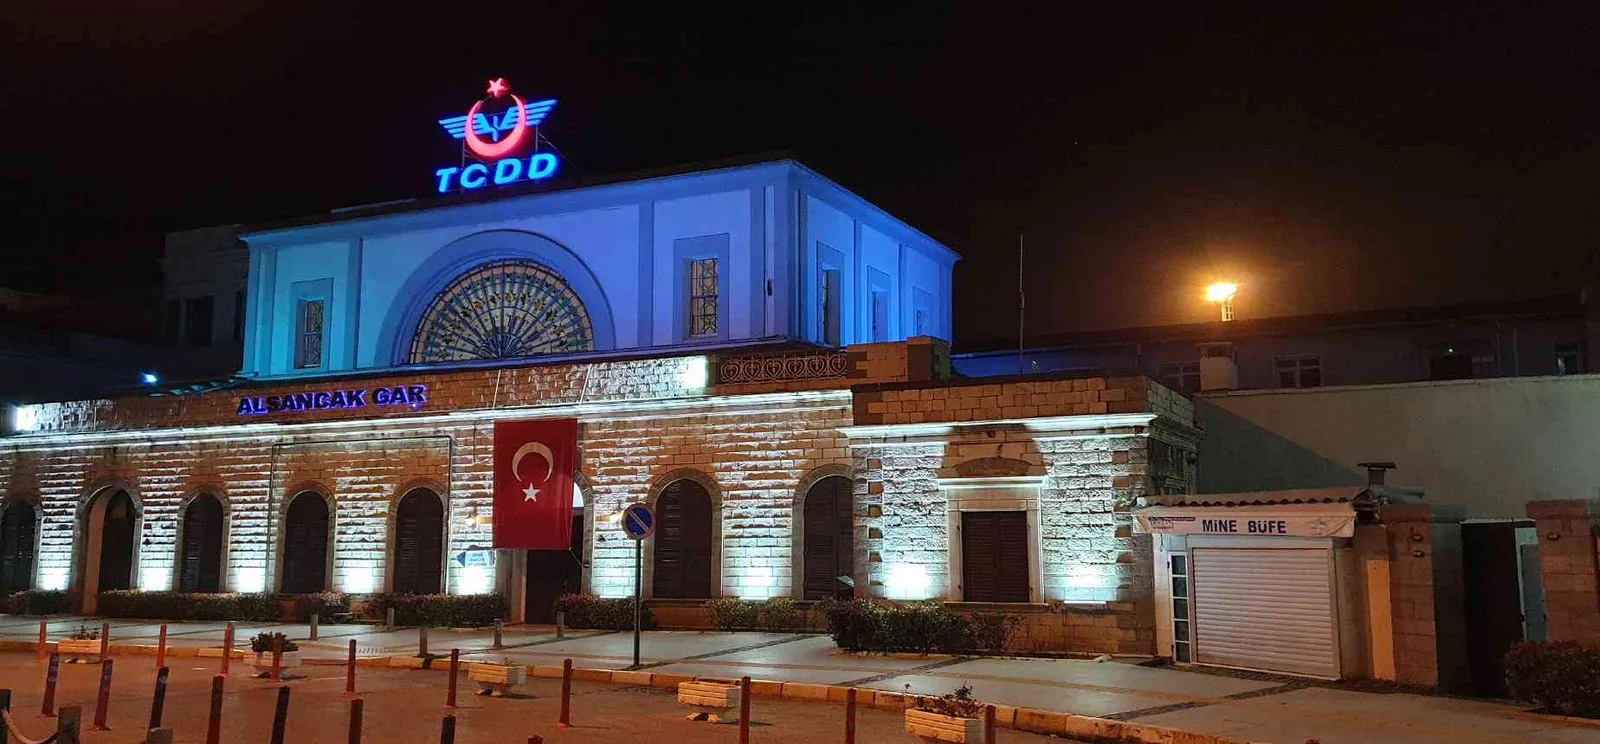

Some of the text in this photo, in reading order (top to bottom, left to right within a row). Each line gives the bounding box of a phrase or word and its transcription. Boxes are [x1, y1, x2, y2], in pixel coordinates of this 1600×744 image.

[436, 153, 557, 192] TCDD
[237, 385, 426, 415] ALSANCAK GAR
[1248, 520, 1287, 534] BÜFE
